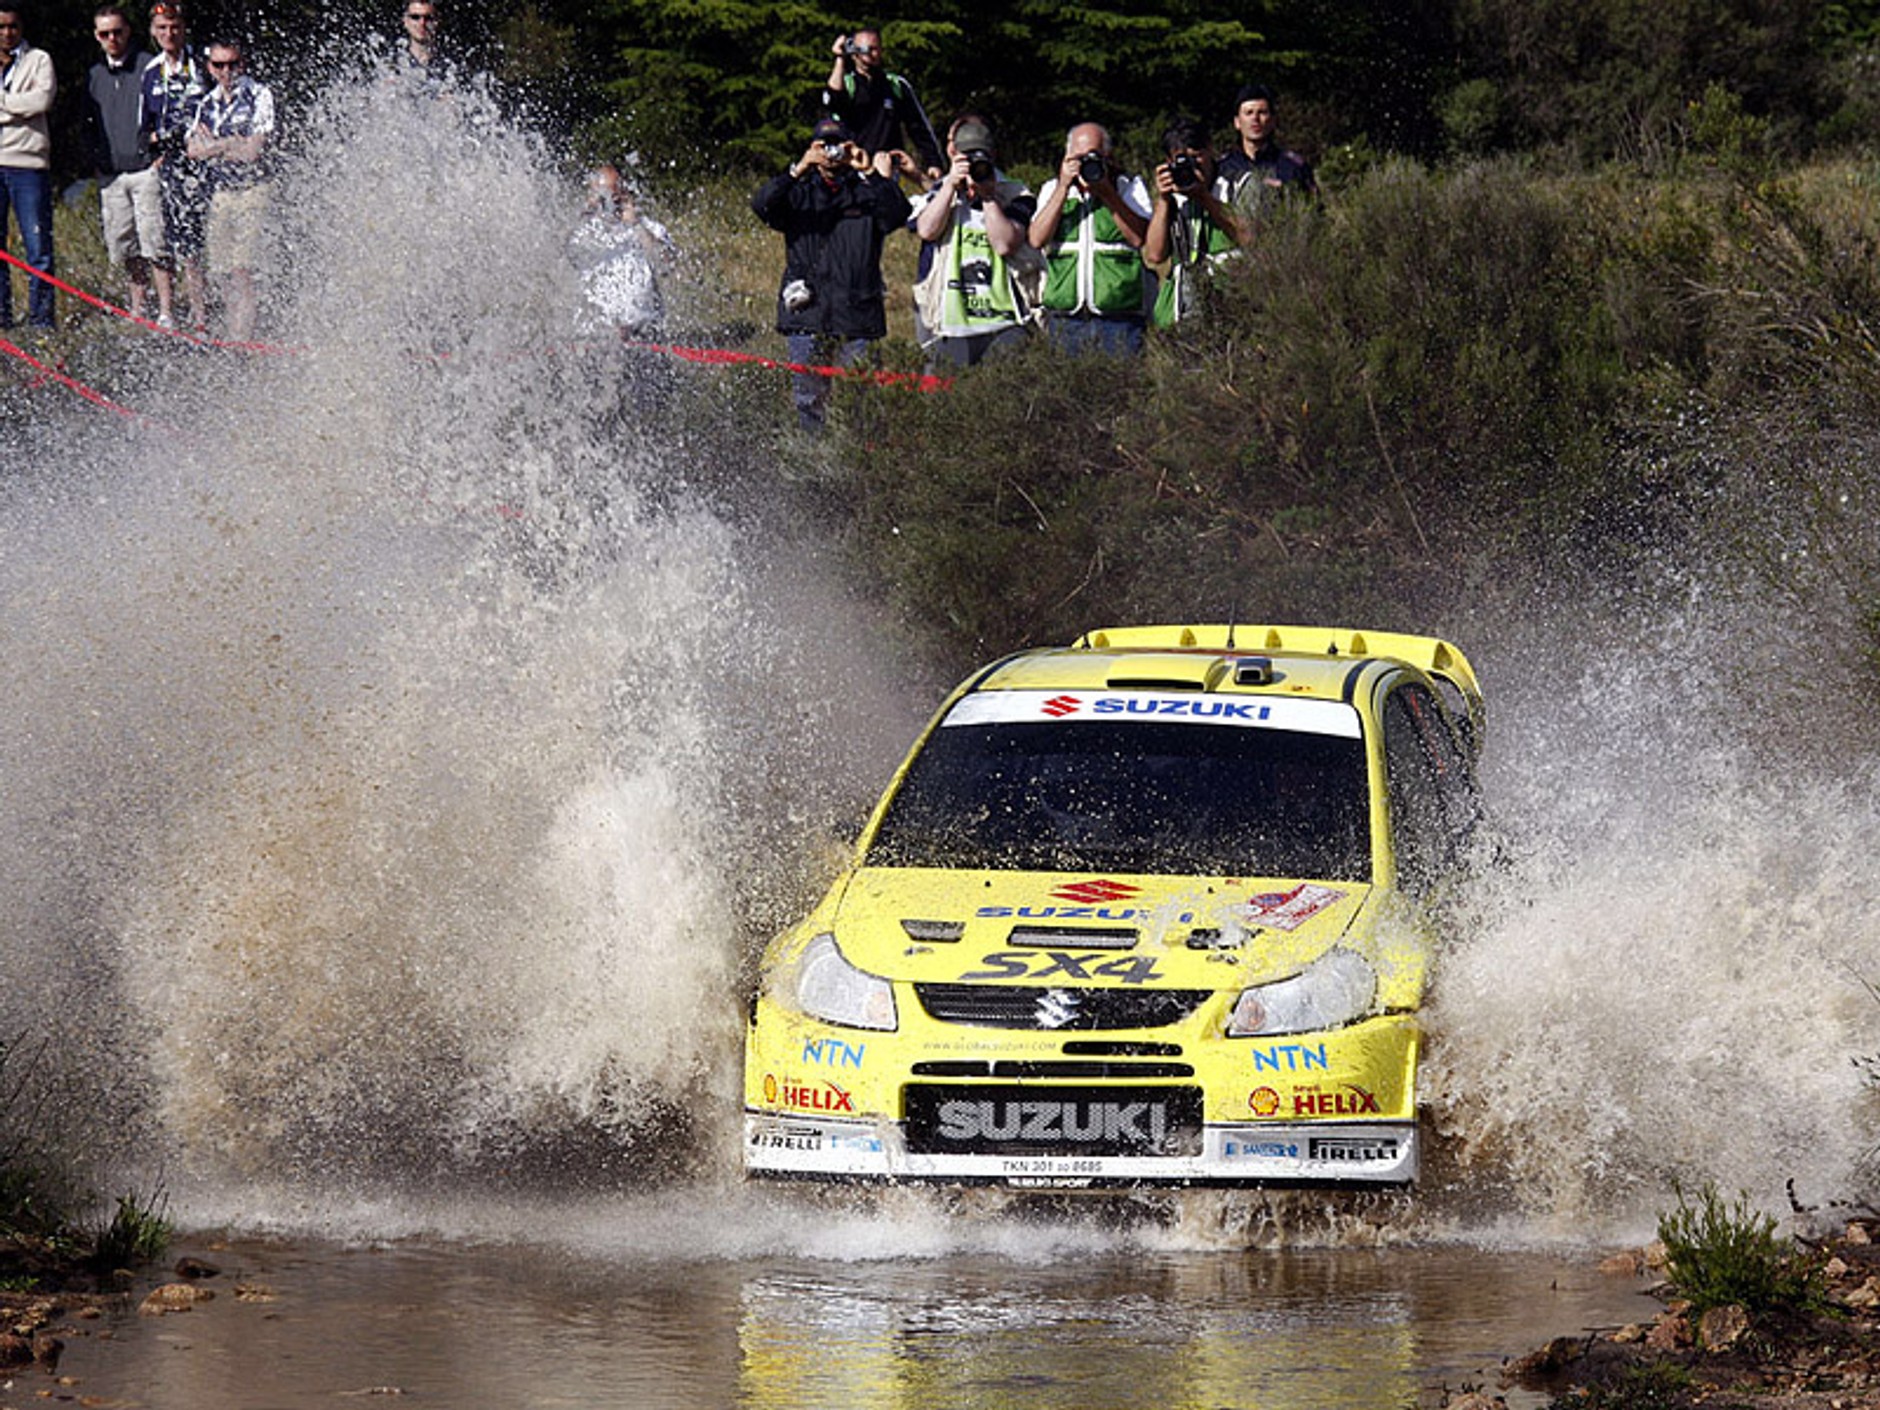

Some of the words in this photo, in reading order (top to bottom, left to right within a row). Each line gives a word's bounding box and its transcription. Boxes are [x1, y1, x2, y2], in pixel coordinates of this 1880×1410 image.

[1093, 696, 1271, 721] SUZUKI
[961, 951, 1165, 984] SX4
[801, 1039, 866, 1069] NTN
[1251, 1044, 1330, 1072] NTN
[783, 1086, 853, 1112] HELIX
[1293, 1087, 1381, 1116] HELIX
[938, 1100, 1166, 1143] SUZUKI
[1308, 1138, 1398, 1161] PIRELLI
[1002, 1160, 1029, 1172] TKN
